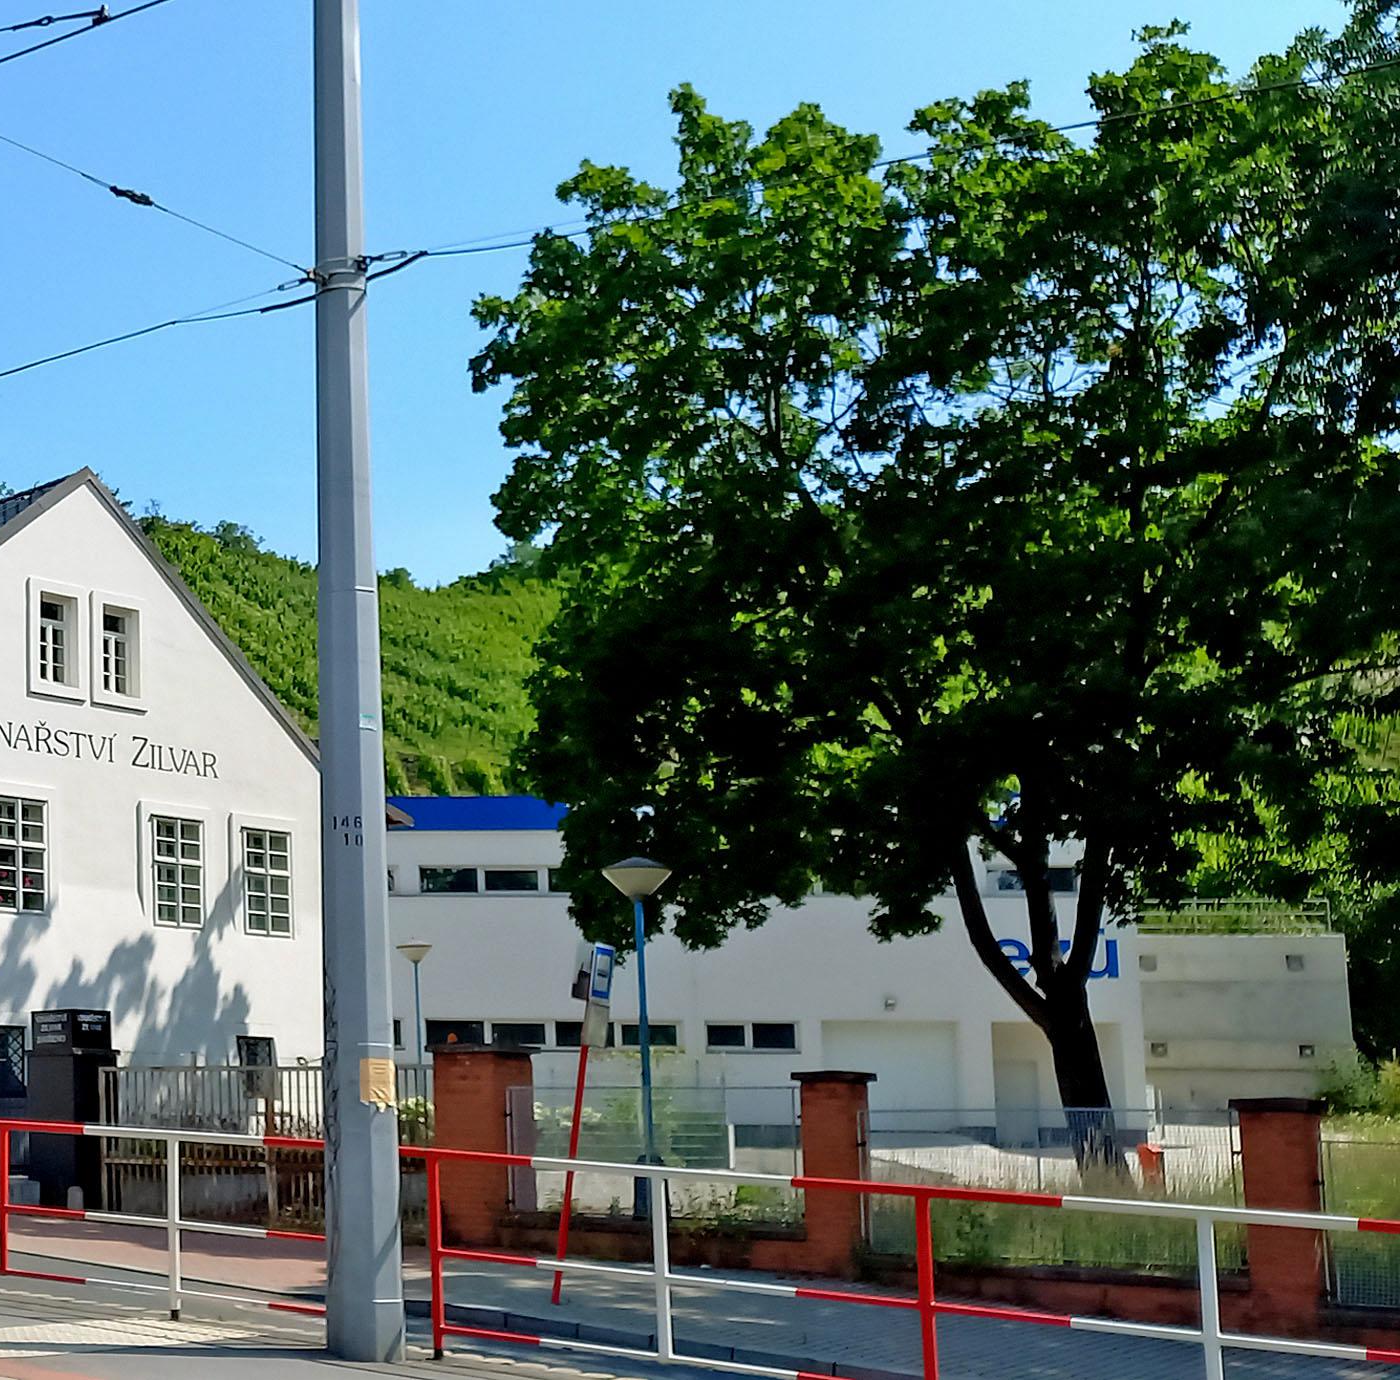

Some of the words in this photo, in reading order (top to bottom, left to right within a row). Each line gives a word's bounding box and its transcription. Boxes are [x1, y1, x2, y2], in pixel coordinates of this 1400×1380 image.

[131, 736, 219, 779] ZILVAR
[333, 815, 363, 830] 146
[344, 832, 363, 847] 10
